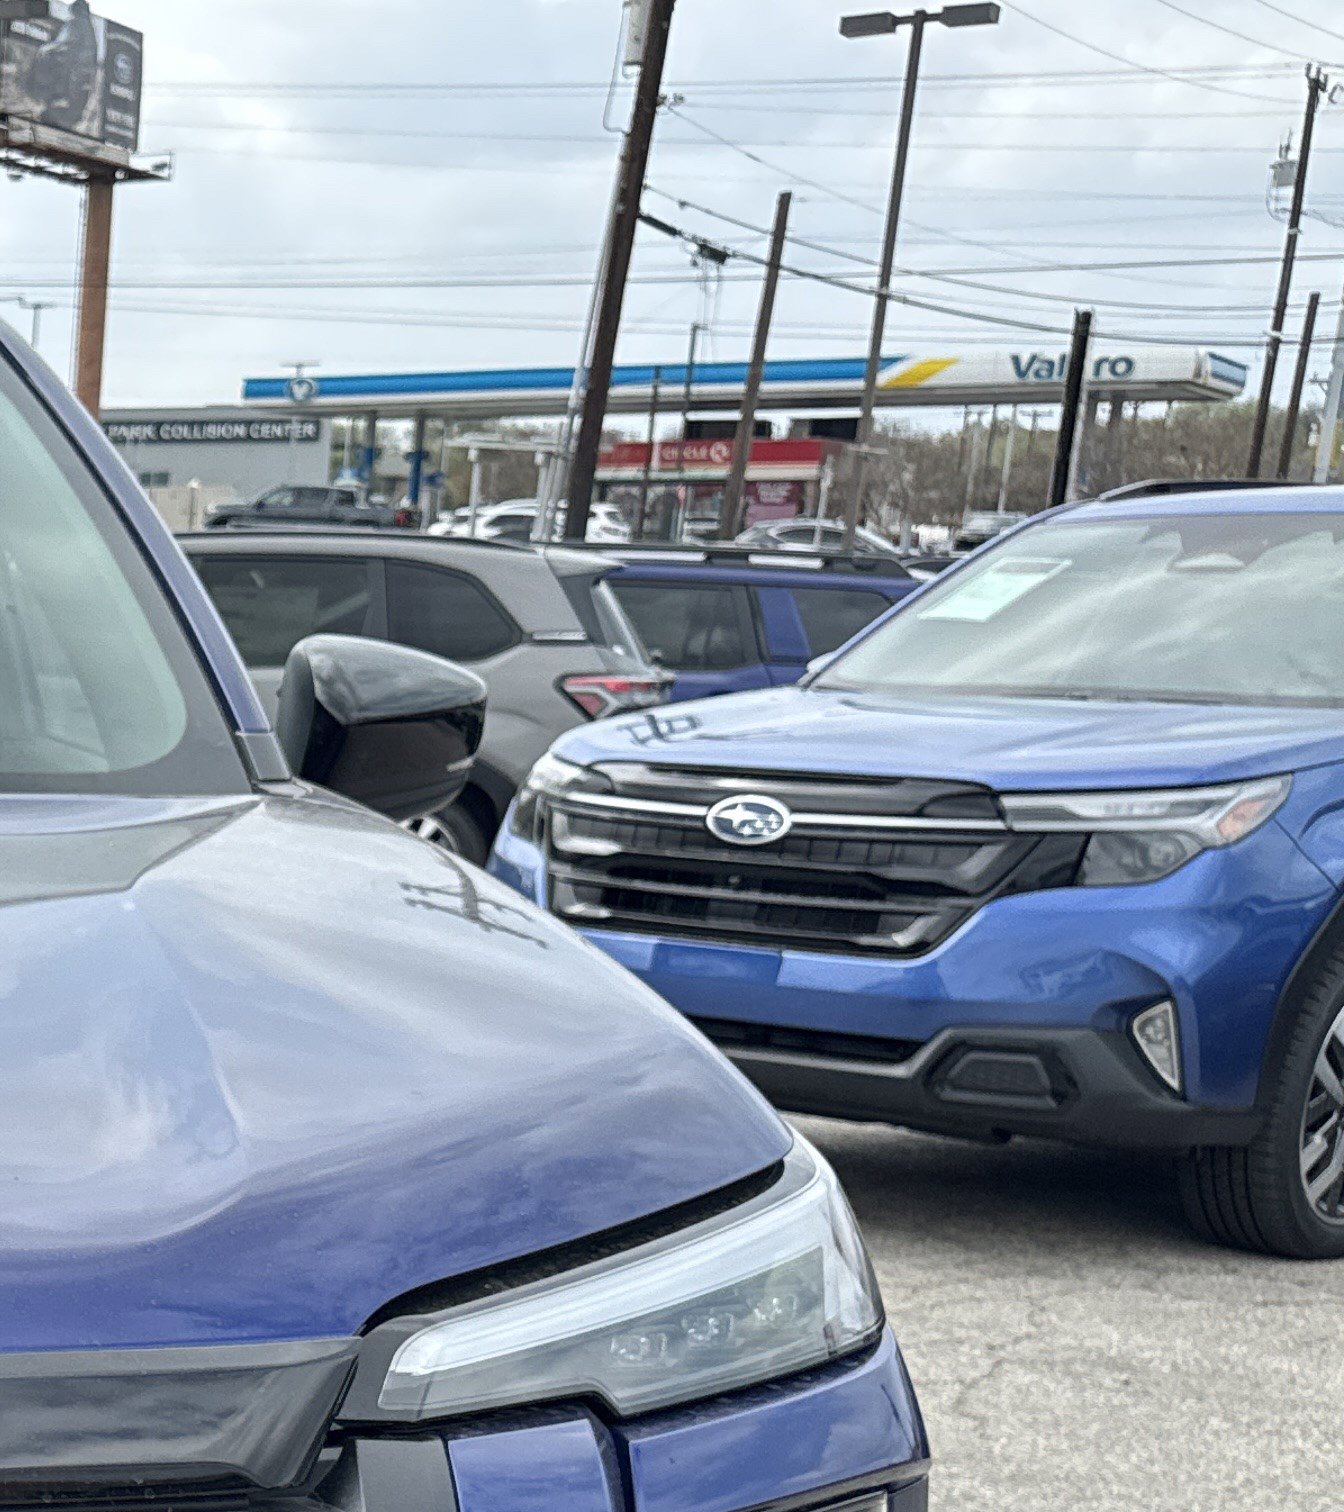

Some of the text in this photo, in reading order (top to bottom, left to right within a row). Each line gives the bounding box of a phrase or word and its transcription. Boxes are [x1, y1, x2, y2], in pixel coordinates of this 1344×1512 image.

[1010, 353, 1135, 379] Valro
[159, 423, 247, 440] COLLISION
[249, 422, 316, 439] CENTER
